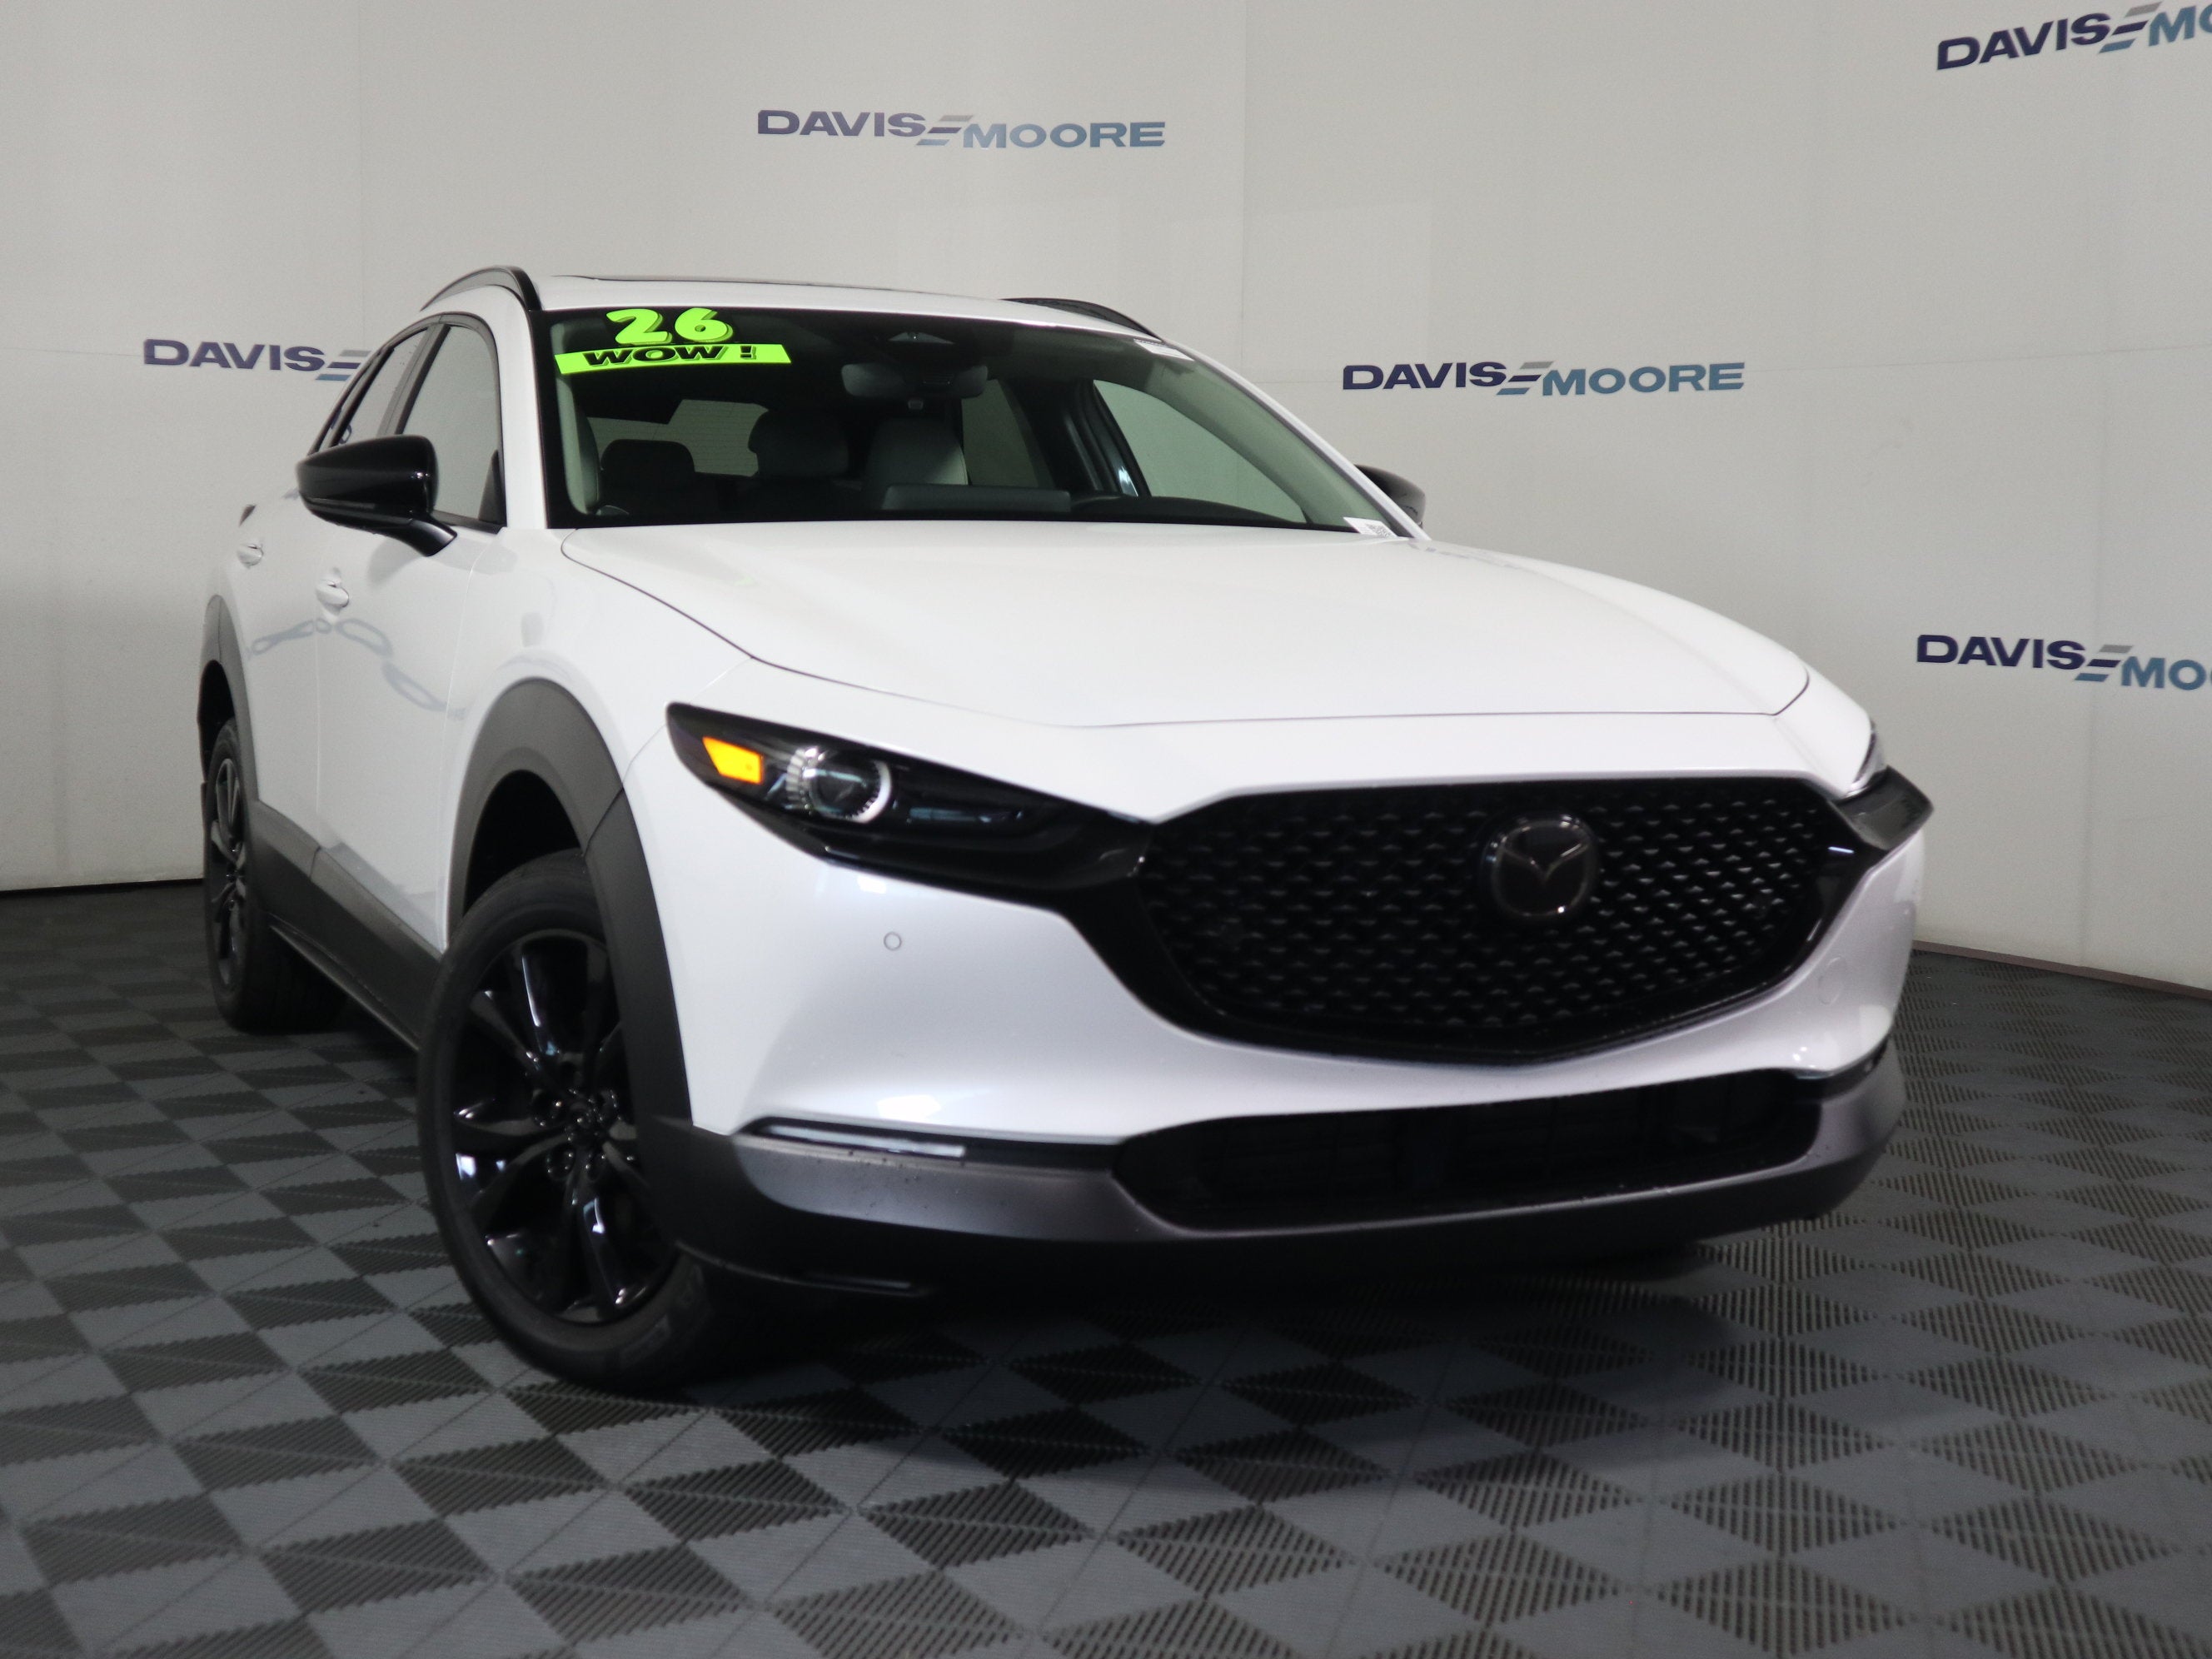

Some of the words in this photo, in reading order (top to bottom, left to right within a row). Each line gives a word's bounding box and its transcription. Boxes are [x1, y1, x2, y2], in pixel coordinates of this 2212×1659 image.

[1936, 12, 2111, 70] DAVIS
[757, 109, 926, 137] DAVIS
[962, 122, 1166, 149] MOORE
[606, 307, 733, 345] 26
[143, 337, 325, 371] DAVIS
[1342, 361, 1507, 390] DAVIS
[1542, 361, 1746, 396] MOORE
[1916, 634, 2086, 670] DAVIS
[2120, 655, 2212, 690] MO
